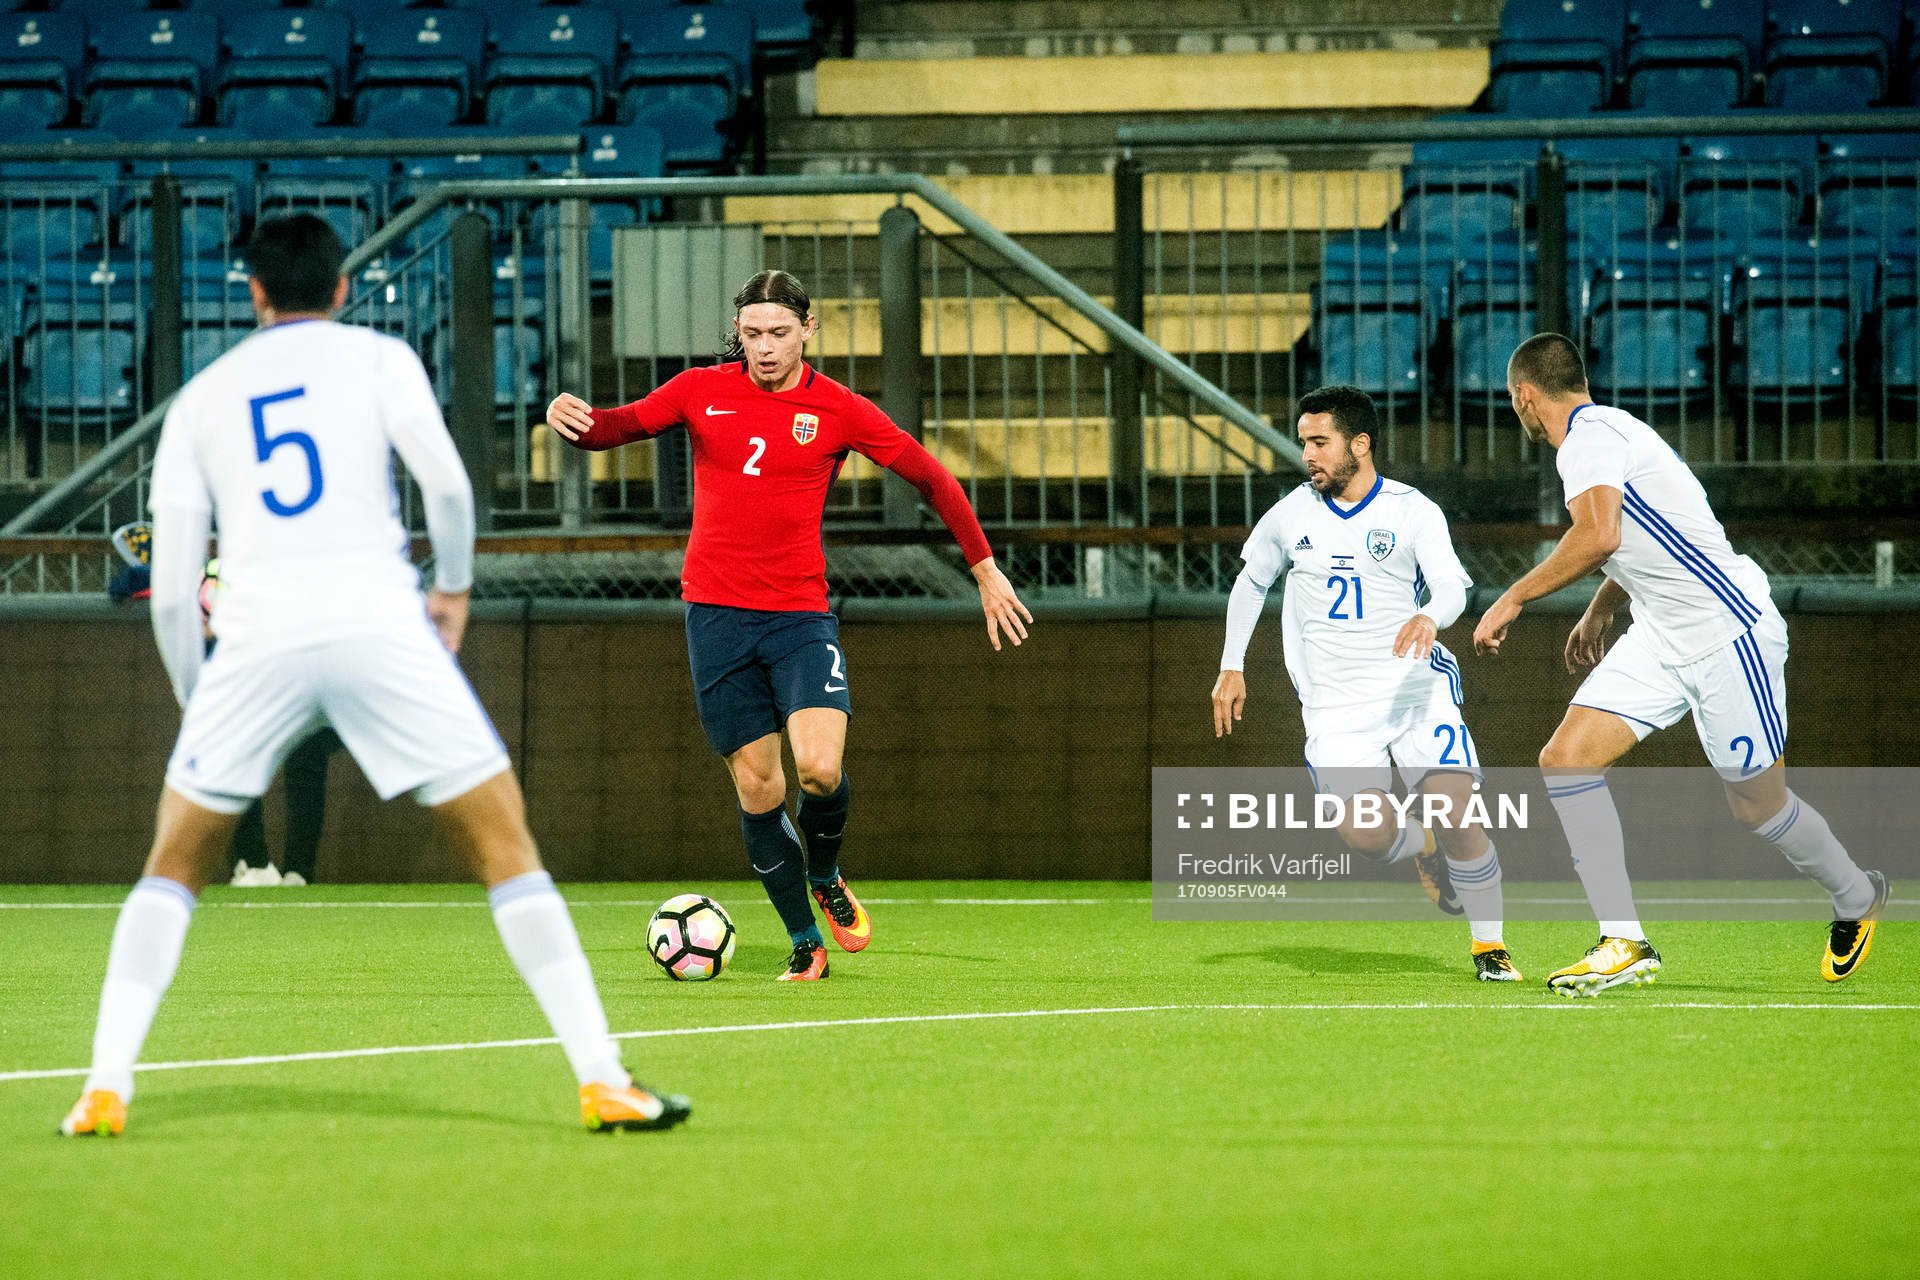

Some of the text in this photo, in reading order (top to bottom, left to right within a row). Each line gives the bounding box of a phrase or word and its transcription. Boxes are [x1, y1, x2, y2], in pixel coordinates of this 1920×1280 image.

[250, 387, 323, 517] 5
[742, 436, 767, 477] 2
[1371, 531, 1391, 539] ISRAEL
[1327, 575, 1363, 620] 21
[825, 643, 844, 681] 2
[1434, 724, 1472, 767] 21
[1729, 735, 1763, 777] 2
